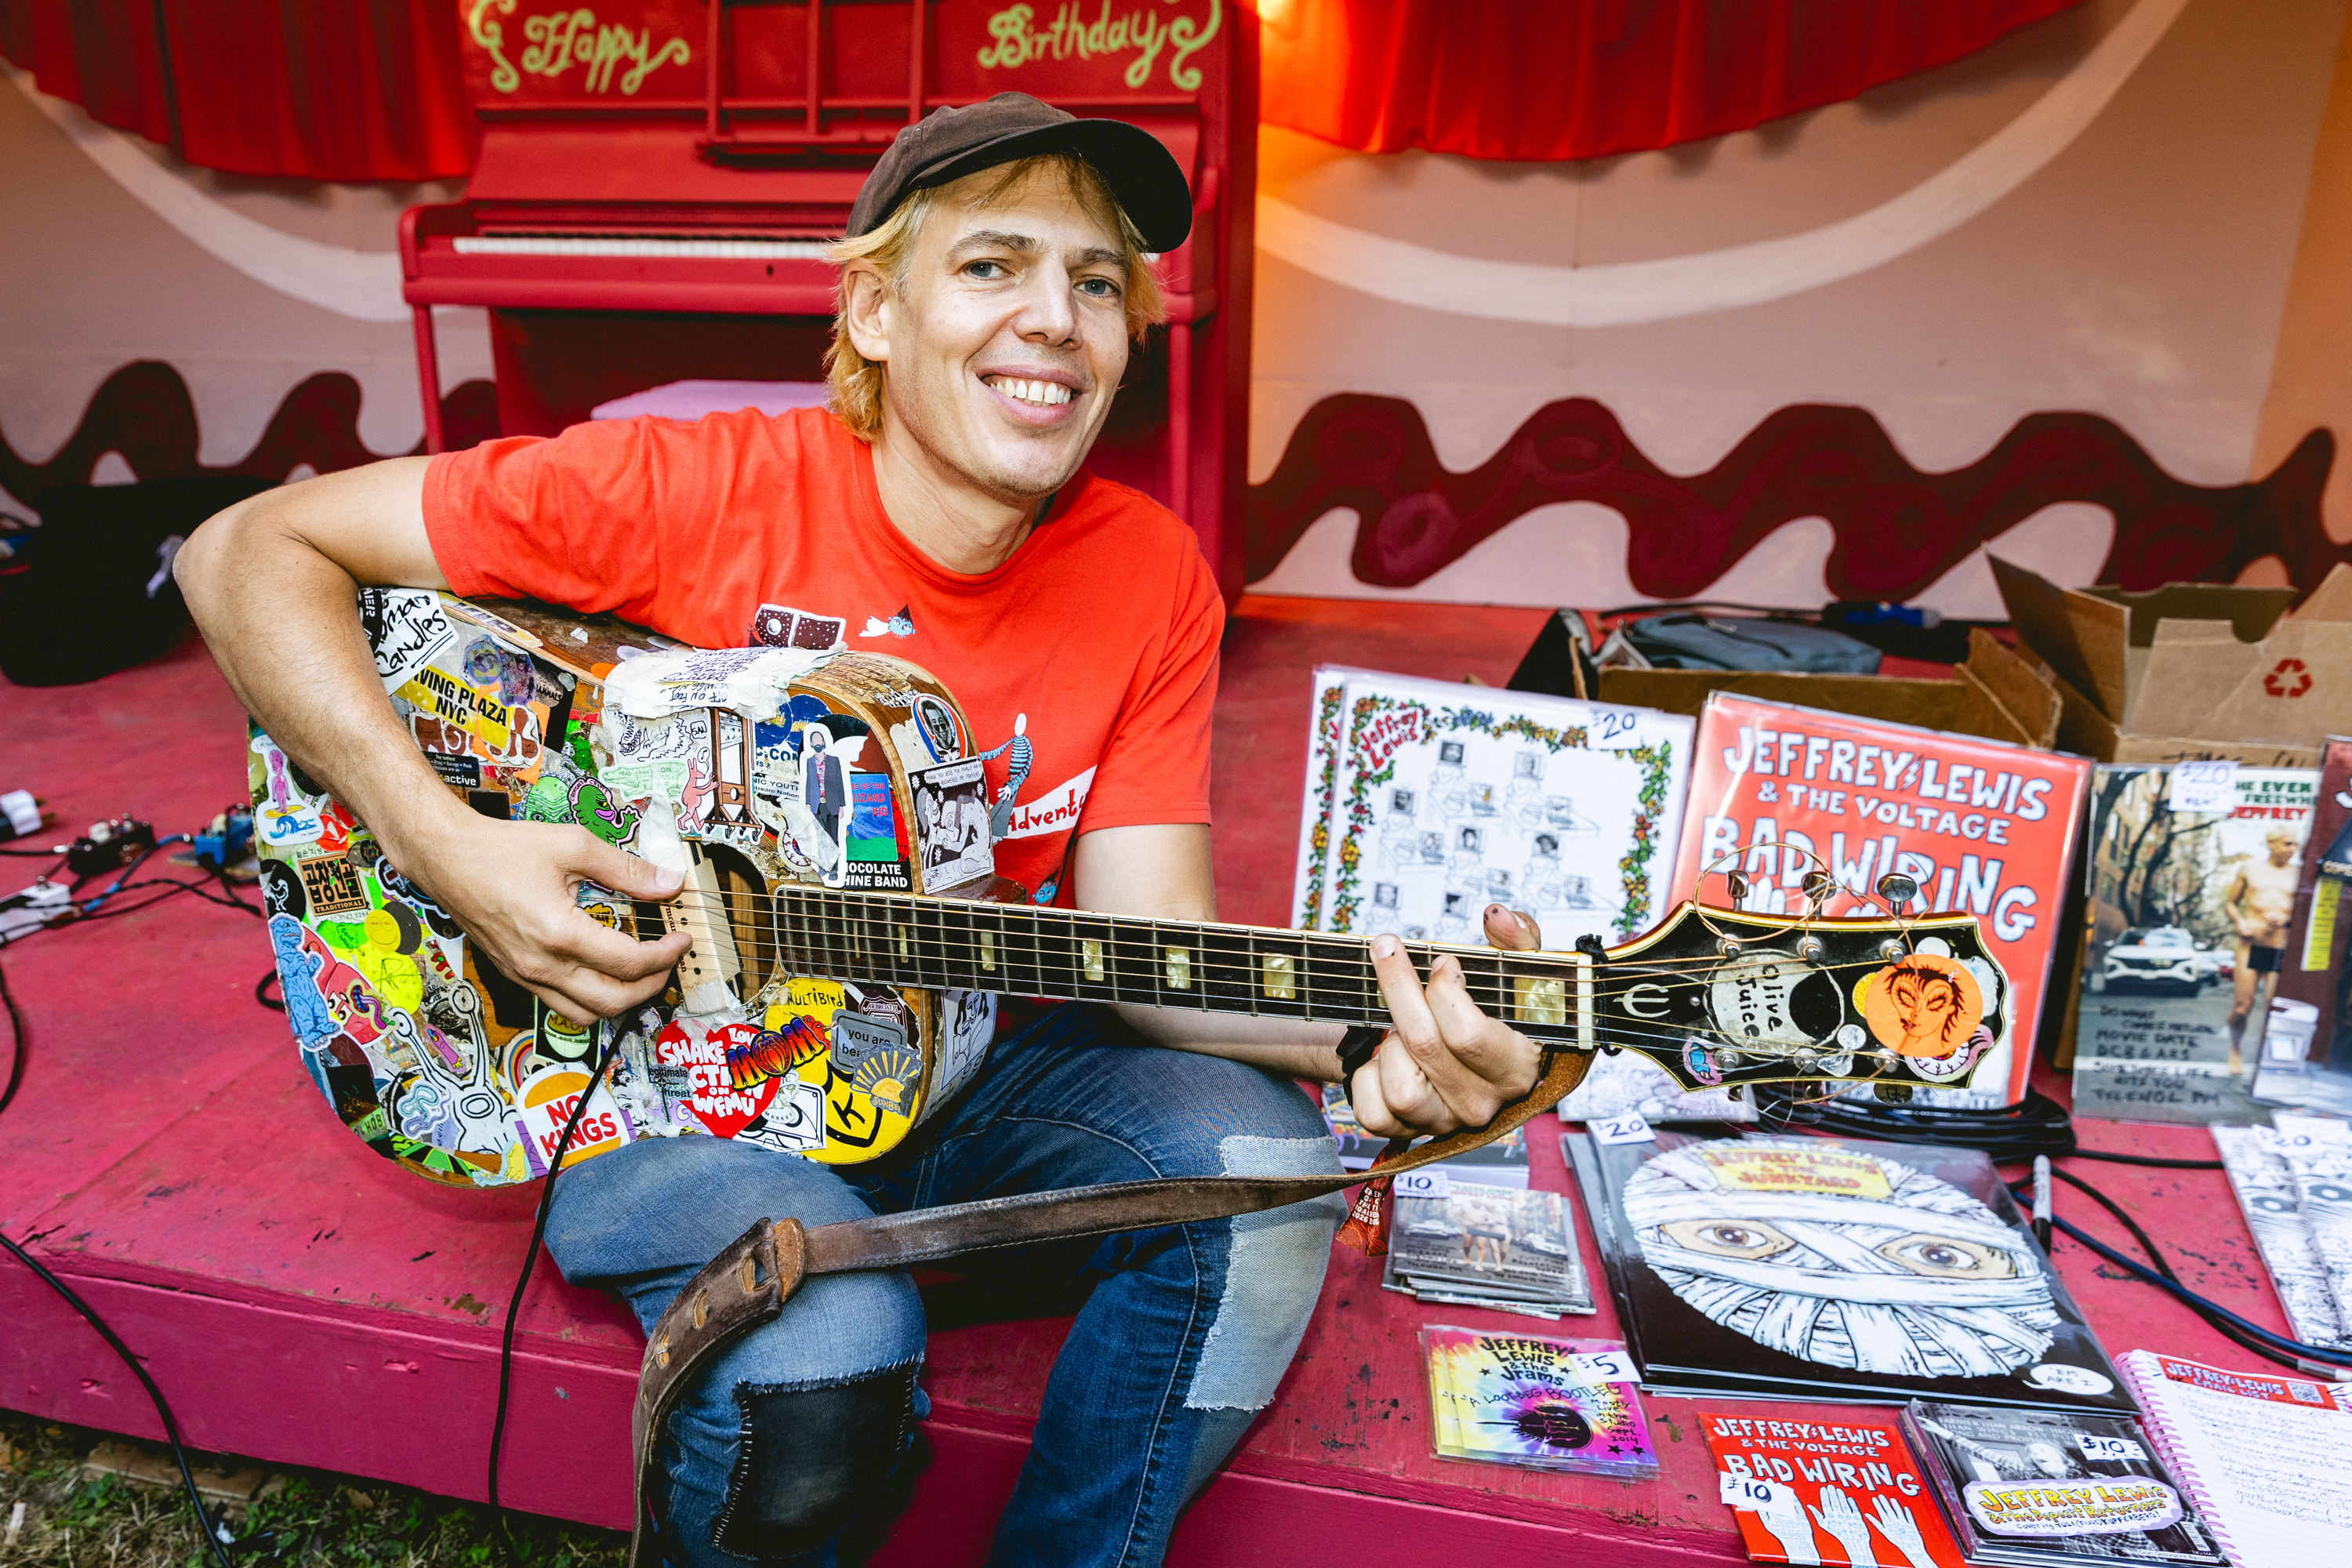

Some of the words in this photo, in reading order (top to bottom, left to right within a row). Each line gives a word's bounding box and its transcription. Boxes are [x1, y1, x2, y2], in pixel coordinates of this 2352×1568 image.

[522, 10, 689, 95] Happy
[978, 2, 1168, 89] Birthday
[413, 668, 456, 700] VING
[458, 687, 507, 727] PLAZA
[435, 696, 467, 726] NYC
[1360, 710, 1417, 752] Jeffrey
[1370, 728, 1418, 770] Lewis
[1722, 726, 1915, 793] JEFFREY
[1917, 757, 2053, 822] LEWIS
[2262, 782, 2311, 793] EVEN
[852, 793, 885, 803] LIZARD
[872, 807, 888, 816] KID
[1756, 780, 1779, 804] &
[1786, 783, 1847, 815] THE
[1853, 795, 2012, 846] VOLTAGE
[2227, 806, 2309, 820] JEFFREY
[874, 877, 908, 888] BAND
[1699, 815, 1816, 889] BAD
[1829, 831, 2039, 942] WIRING
[315, 900, 363, 913] TRADITIONAL
[848, 1029, 869, 1043] you
[658, 1039, 726, 1067] SHAKE
[709, 1086, 730, 1095] ON
[2092, 1087, 2184, 1103] TYLENOL
[546, 1094, 587, 1127] NO
[692, 1091, 756, 1118] WFMU
[764, 1110, 794, 1121] MARKET
[1708, 1151, 1801, 1167] JEFFREY
[1806, 1154, 1878, 1174] LEWIS
[1777, 1165, 1818, 1174] THE
[1738, 1171, 1861, 1189] JUNKYARD
[1352, 1210, 1369, 1223] 2026
[1479, 1336, 1570, 1358] JEFFREY
[1492, 1350, 1555, 1367] LEWIS
[1520, 1361, 1549, 1372] the
[1500, 1365, 1566, 1387] Jrams
[2047, 1376, 2075, 1385] ARE
[2165, 1361, 2233, 1383] JEFFREY
[2233, 1376, 2286, 1396] LEWIS
[1544, 1382, 1622, 1400] BOOTLEG
[2194, 1377, 2237, 1394] EMAIL
[2238, 1388, 2271, 1400] LIST
[1606, 1412, 1630, 1421] the
[1713, 1417, 1812, 1439] JEFFREY
[1820, 1425, 1890, 1448] LEWIS
[1976, 1426, 2016, 1436] WINGS
[2009, 1423, 2045, 1432] ARROW
[1610, 1436, 1640, 1445] 2014
[1740, 1437, 1754, 1448] &
[1757, 1438, 1791, 1450] THE
[1792, 1441, 1881, 1457] VOLTAGE
[1722, 1452, 1795, 1482] BAD
[1794, 1456, 1921, 1497] WIRING
[1979, 1487, 2092, 1512] JEFFREY
[2094, 1486, 2168, 1503] LEWIS
[1984, 1511, 2007, 1524] &
[2085, 1499, 2167, 1519] Returners
